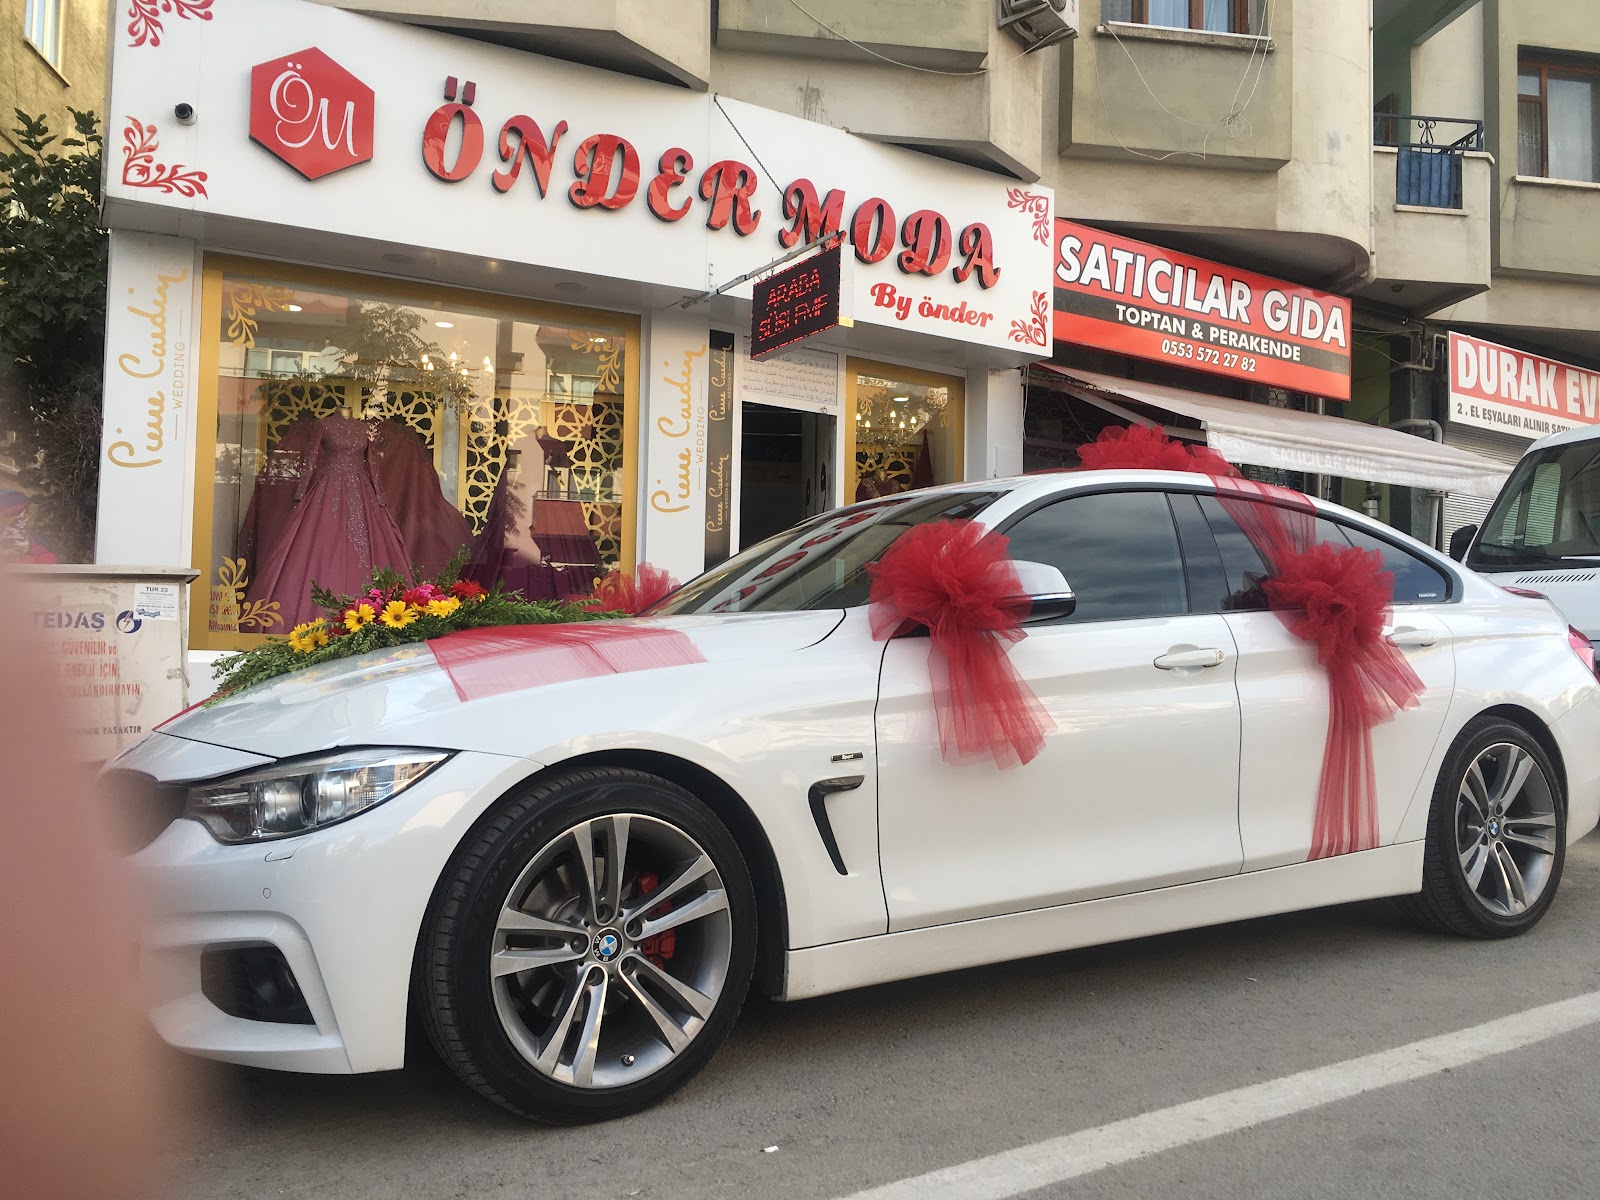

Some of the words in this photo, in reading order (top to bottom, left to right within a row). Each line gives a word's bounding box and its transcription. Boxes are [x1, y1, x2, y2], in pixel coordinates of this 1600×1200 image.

[422, 75, 762, 237] ÖNDER
[777, 178, 1001, 290] MODA
[870, 283, 912, 320] By
[918, 296, 994, 327] önder
[1056, 235, 1252, 324] SATICILAR
[1262, 289, 1347, 348] GIDA
[1115, 304, 1186, 335] TOPTAN
[1191, 323, 1204, 340] &
[1209, 326, 1301, 362] PERAKENDE
[1161, 339, 1194, 359] 0553
[1196, 347, 1219, 363] 572
[1223, 353, 1239, 368] 27
[1241, 356, 1256, 373] 82
[172, 341, 186, 410] WEDDING
[1457, 339, 1559, 411] DURAK
[1565, 368, 1600, 420] EV
[696, 406, 705, 464] WEDDING
[1470, 405, 1481, 419] EL
[1482, 407, 1521, 428] EŞYALARI
[1523, 418, 1550, 434] ALINIR
[1270, 446, 1342, 471] SATICILAR
[1345, 455, 1377, 475] GIDA
[32, 611, 105, 632] TEDAŞ
[102, 725, 142, 735] YASAKTIR
